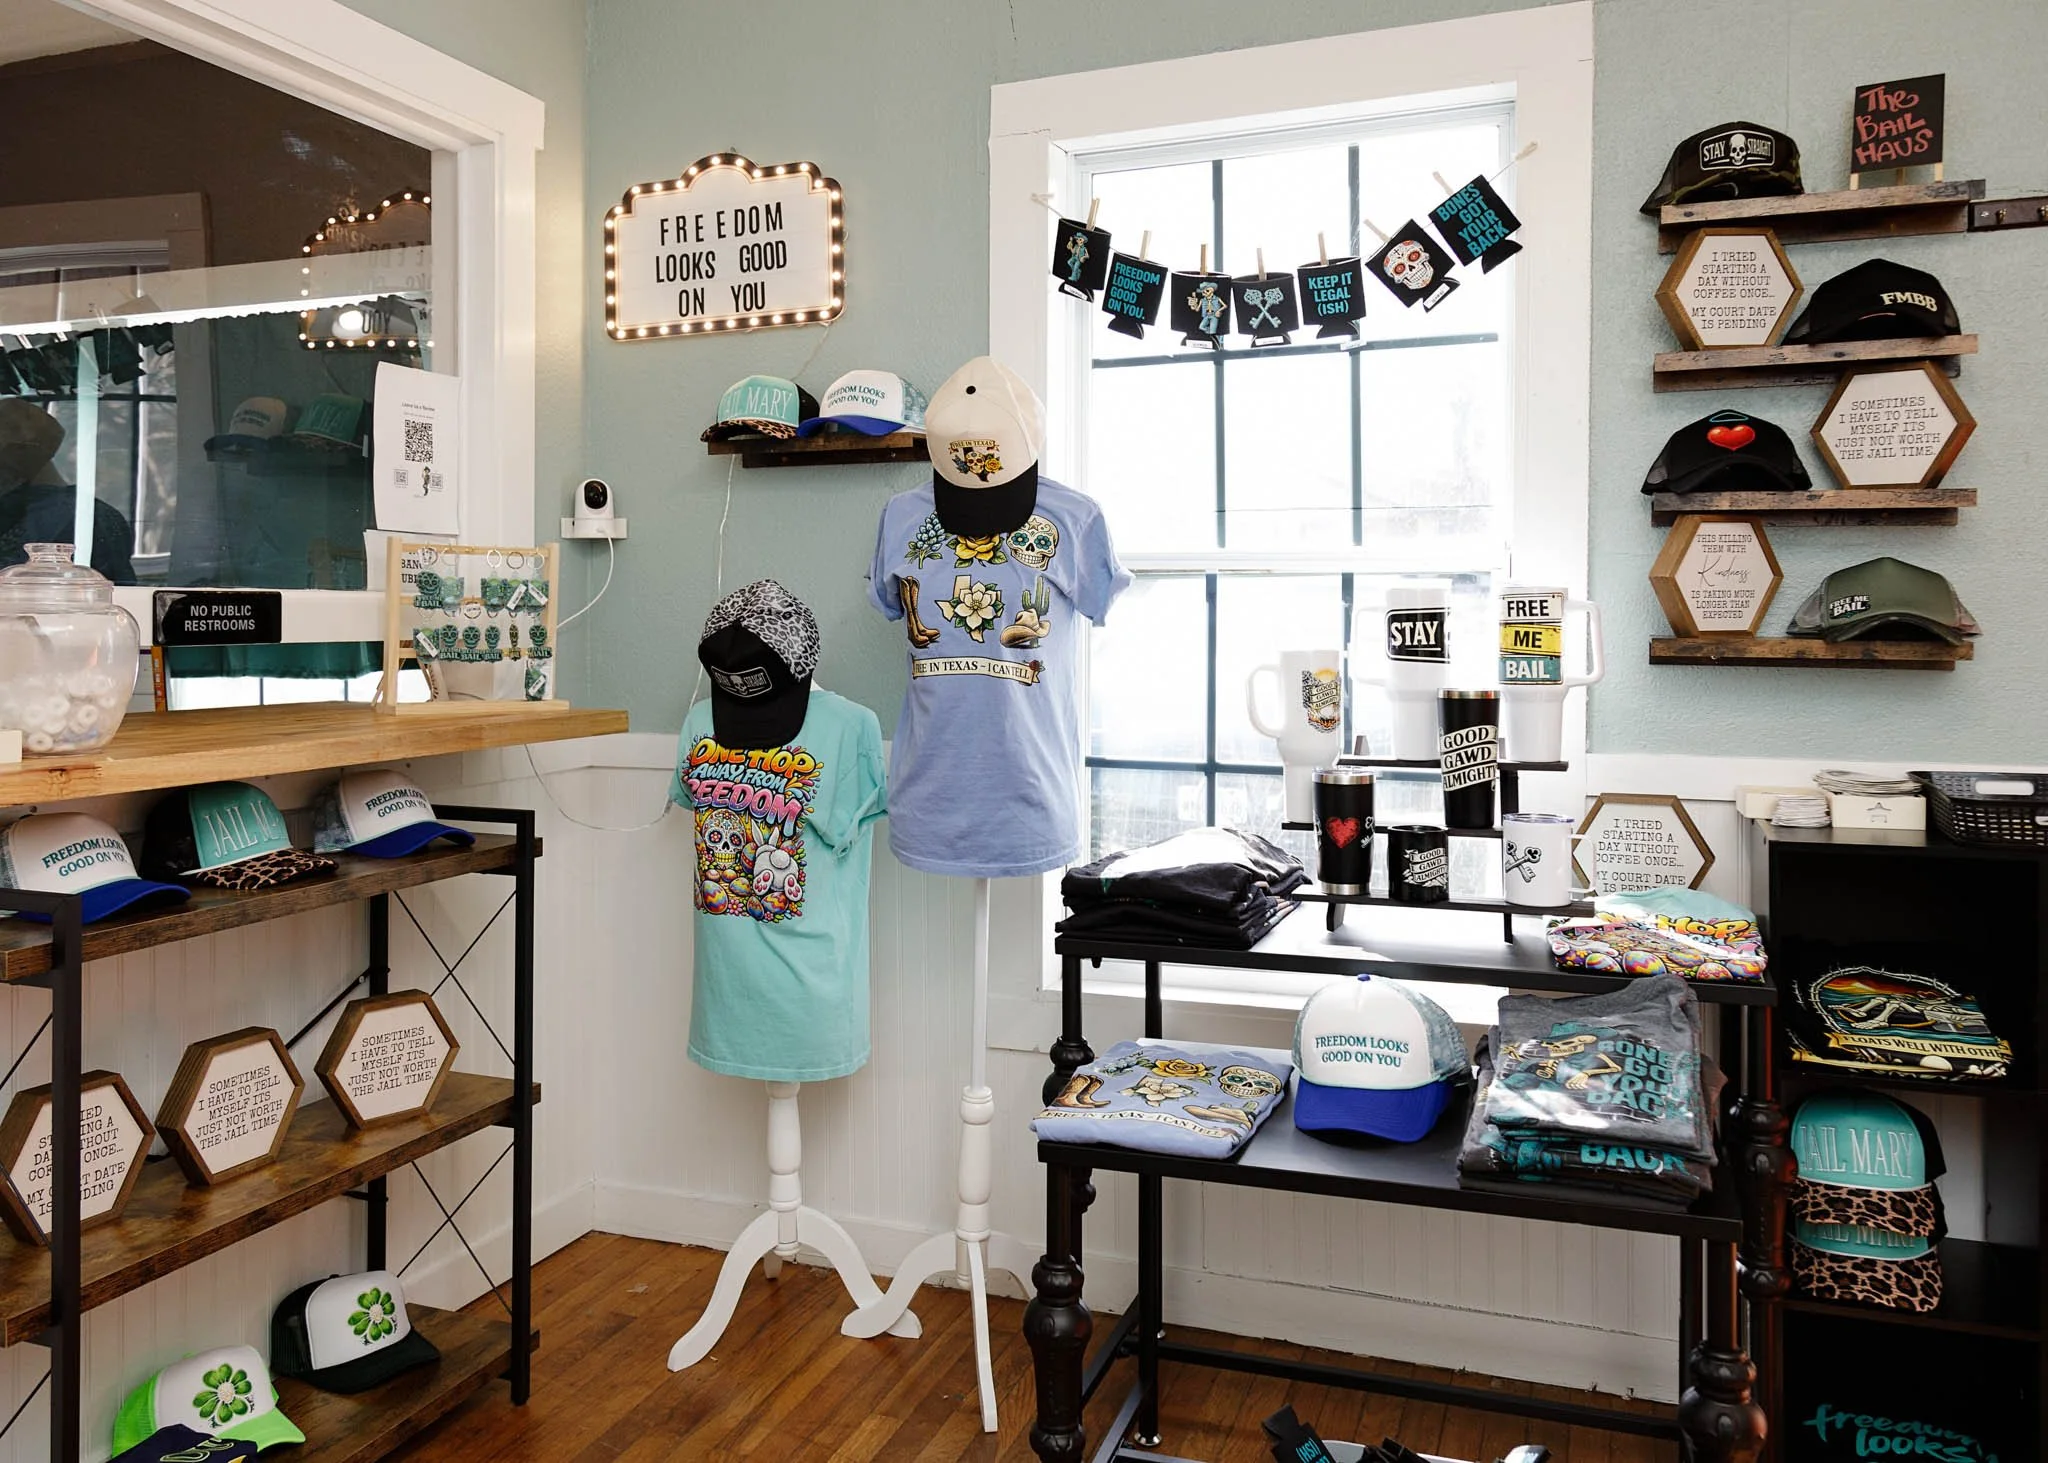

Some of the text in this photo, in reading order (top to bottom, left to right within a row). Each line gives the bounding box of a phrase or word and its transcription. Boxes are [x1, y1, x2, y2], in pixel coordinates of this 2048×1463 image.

[1859, 85, 1919, 112] The
[1856, 112, 1926, 143] BAIL
[1703, 140, 1726, 162] STAY
[1856, 128, 1933, 165] HAUS
[1436, 183, 1480, 222] BONES
[1459, 195, 1488, 224] GOT
[660, 202, 783, 246] FREEDOM
[1458, 209, 1499, 242] YOUR
[1467, 220, 1510, 257] BACK
[655, 240, 787, 283] LOOKS GOOD
[1712, 251, 1757, 262] I TRIED
[1115, 262, 1160, 285] FREEDOM
[1702, 264, 1767, 274] STARTING A
[1113, 273, 1143, 293] LOOKS
[1308, 272, 1353, 290] KEEP IT
[1698, 276, 1771, 286] DAY WITHOUT
[678, 281, 766, 317] ON YOU
[1110, 286, 1137, 304] GOOD
[1313, 287, 1351, 303] LEGAL
[1693, 288, 1737, 299] COFFEE
[1880, 291, 1937, 311] FMBB
[1108, 298, 1145, 320] ON YOU.
[1317, 302, 1349, 317] (ISH)
[1692, 306, 1777, 317] MY COURT DATE
[1701, 319, 1767, 329] IS PENDING
[847, 394, 878, 406] ON YOU
[858, 385, 885, 399] LOOKS
[745, 386, 793, 419] MARY
[1851, 396, 1926, 411] SOMETIMES
[1839, 407, 1938, 424] I HAVE TO TELL
[1850, 421, 1926, 435] MYSELF ITS
[1835, 433, 1941, 448] JUST NOT WORTH
[1839, 450, 1865, 460] THE
[1867, 447, 1897, 459] JAIL
[1696, 534, 1752, 543] THIS KILLING
[1702, 544, 1747, 553] THEM WITH
[1691, 589, 1755, 599] IS TAKING MUCH
[1830, 597, 1852, 609] FREE
[190, 604, 252, 617] NO PUBLIC
[1507, 599, 1550, 617] FREE
[1696, 599, 1750, 609] LONGER THAN
[1833, 601, 1866, 617] BAIL
[1702, 610, 1744, 619] EXPECTED
[184, 619, 256, 632] RESTROOMS
[1391, 621, 1440, 647] STAY
[1513, 630, 1543, 648] ME
[929, 662, 940, 672] IN
[942, 660, 978, 671] TEXAS
[992, 664, 1009, 675] CAN
[1011, 666, 1030, 680] TELL
[1505, 660, 1550, 679] BAIL
[1444, 727, 1489, 749] GOOD
[690, 738, 816, 779] ONE HOP
[1444, 746, 1491, 769] GAWD
[689, 763, 787, 793] AWAY FROM
[365, 788, 408, 811] FREEDOM
[377, 799, 417, 818] GOOD ON
[204, 806, 258, 858] JAIL
[1613, 819, 1662, 830] I TRIED
[1602, 830, 1674, 842] STARTING A
[42, 838, 101, 869] FREEDOM
[1420, 849, 1441, 860] GOOD
[1598, 841, 1679, 854] DAY WITHOUT
[59, 851, 112, 877] GOOD ON
[1419, 859, 1442, 870] GAWD
[1603, 883, 1617, 892] IS
[1611, 872, 1686, 885] COURT DATE
[362, 1026, 425, 1047] SOMETIMES
[1315, 1035, 1409, 1054] FREEDOM LOOKS
[351, 1035, 435, 1062] I HAVE TO TELL
[1892, 1039, 1966, 1055] WELL WITH
[361, 1049, 425, 1072] MYSELF ITS
[1322, 1051, 1402, 1068] GOOD ON YOU
[209, 1065, 271, 1094] SOMETIMES
[347, 1057, 437, 1086] JUST NOT WORTH
[198, 1075, 280, 1111] I HAVE TO TELL
[352, 1070, 434, 1097] THE JAIL TIME.
[208, 1091, 271, 1120] MYSELF ITS
[195, 1099, 283, 1138] JUST NOT WORTH
[199, 1113, 279, 1150] THE JAIL TIME.
[1580, 1144, 1690, 1177] BACK
[1800, 1125, 1913, 1178] JAIL MARY
[27, 1161, 126, 1205] MY DATE
